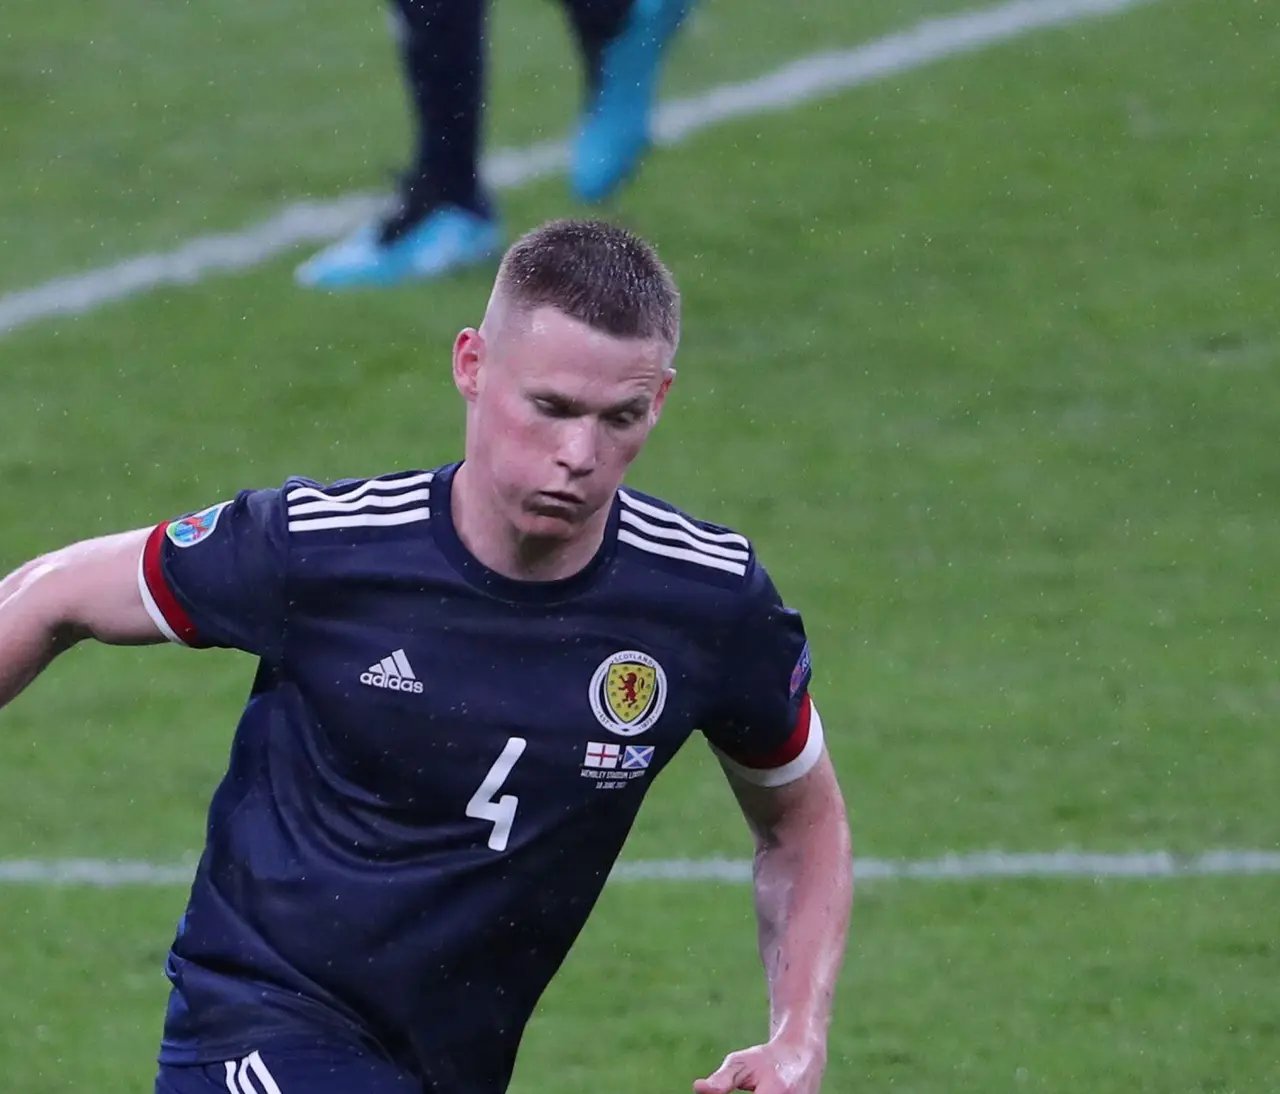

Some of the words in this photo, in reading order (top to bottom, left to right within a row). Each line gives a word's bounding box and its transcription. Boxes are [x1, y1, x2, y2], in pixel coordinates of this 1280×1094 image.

[613, 654, 653, 666] SCOTLAND
[359, 671, 424, 694] adidas
[465, 737, 527, 852] 4
